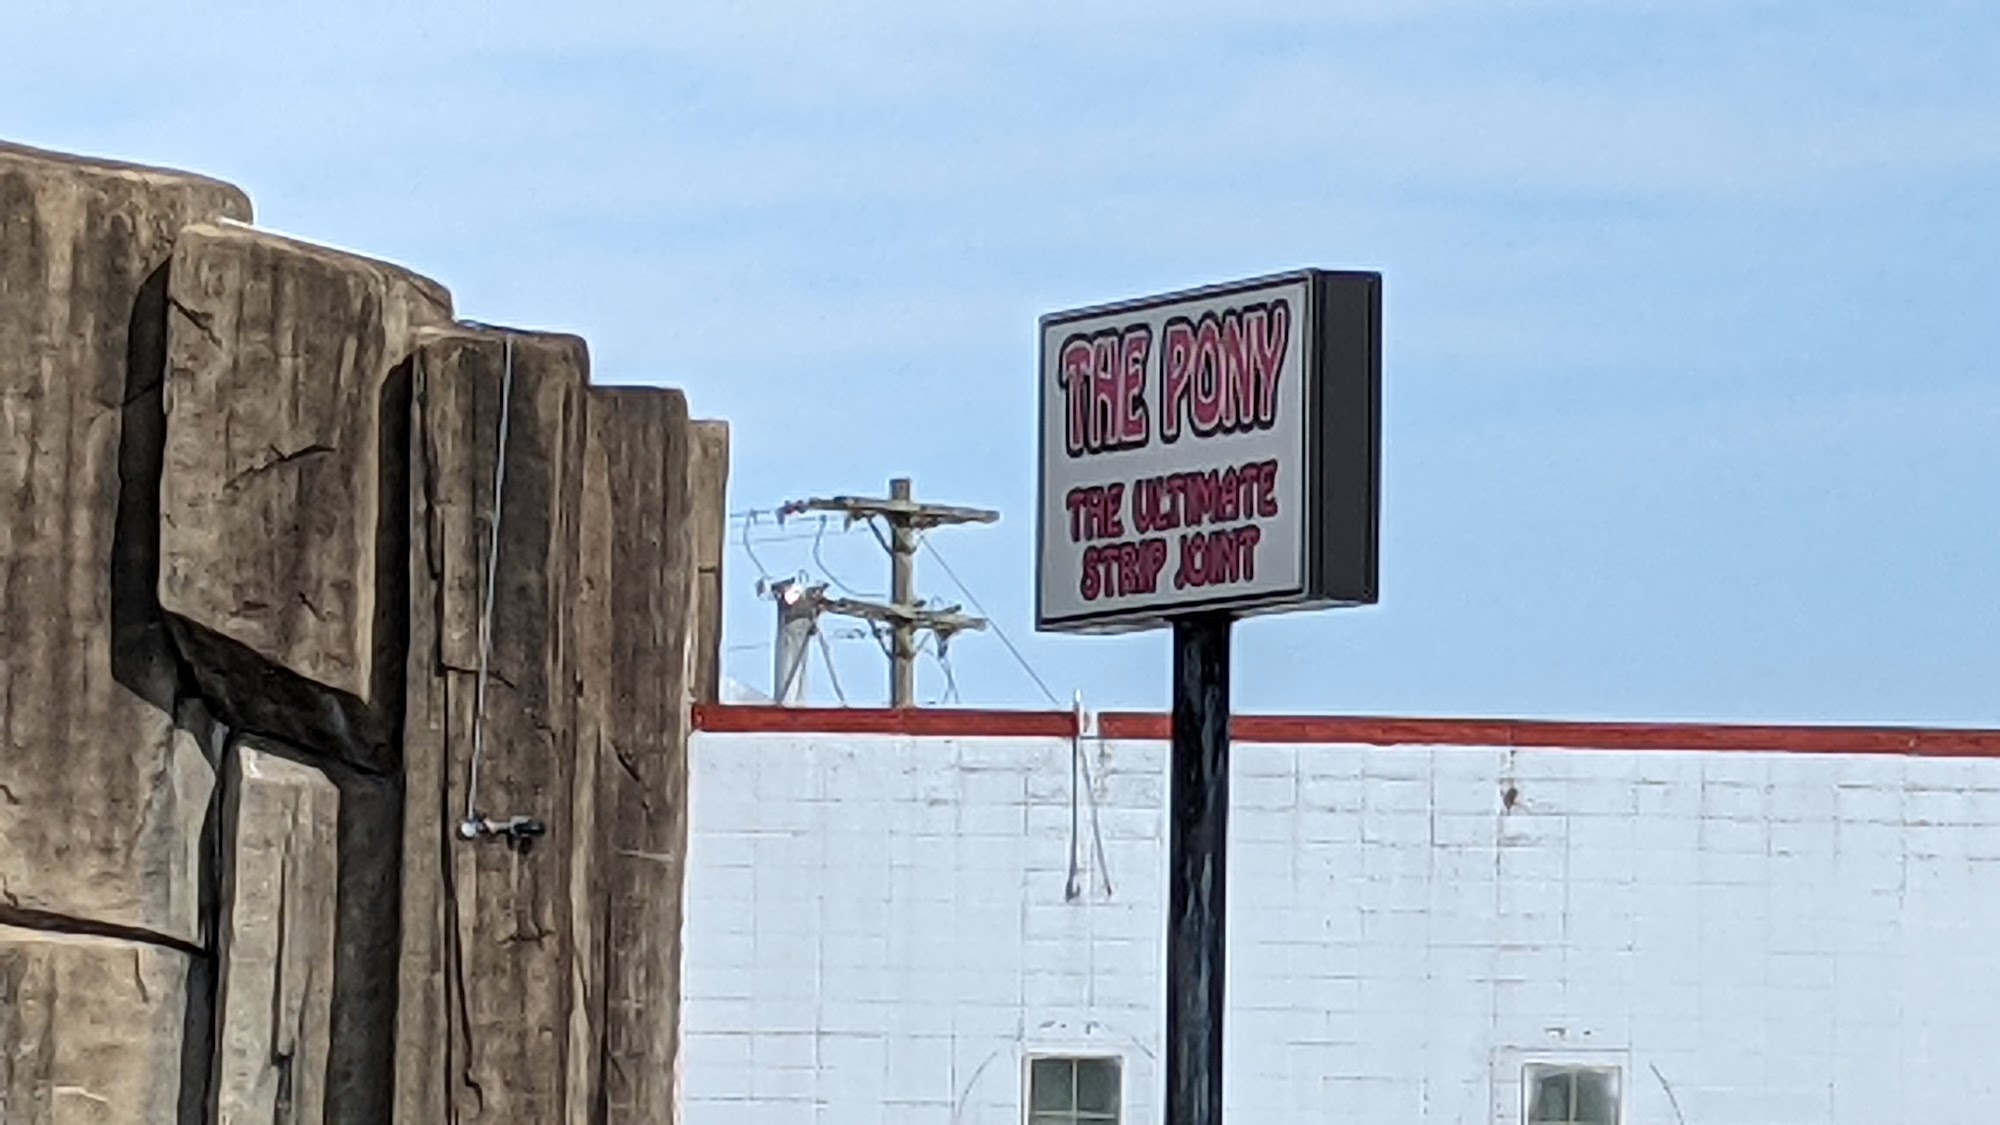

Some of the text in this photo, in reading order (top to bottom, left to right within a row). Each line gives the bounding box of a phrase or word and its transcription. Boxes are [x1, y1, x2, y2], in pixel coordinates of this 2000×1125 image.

[1059, 299, 1291, 457] THE PONY
[1066, 459, 1278, 542] THE ULTIMATE
[1080, 524, 1260, 601] STRIP JOINT
